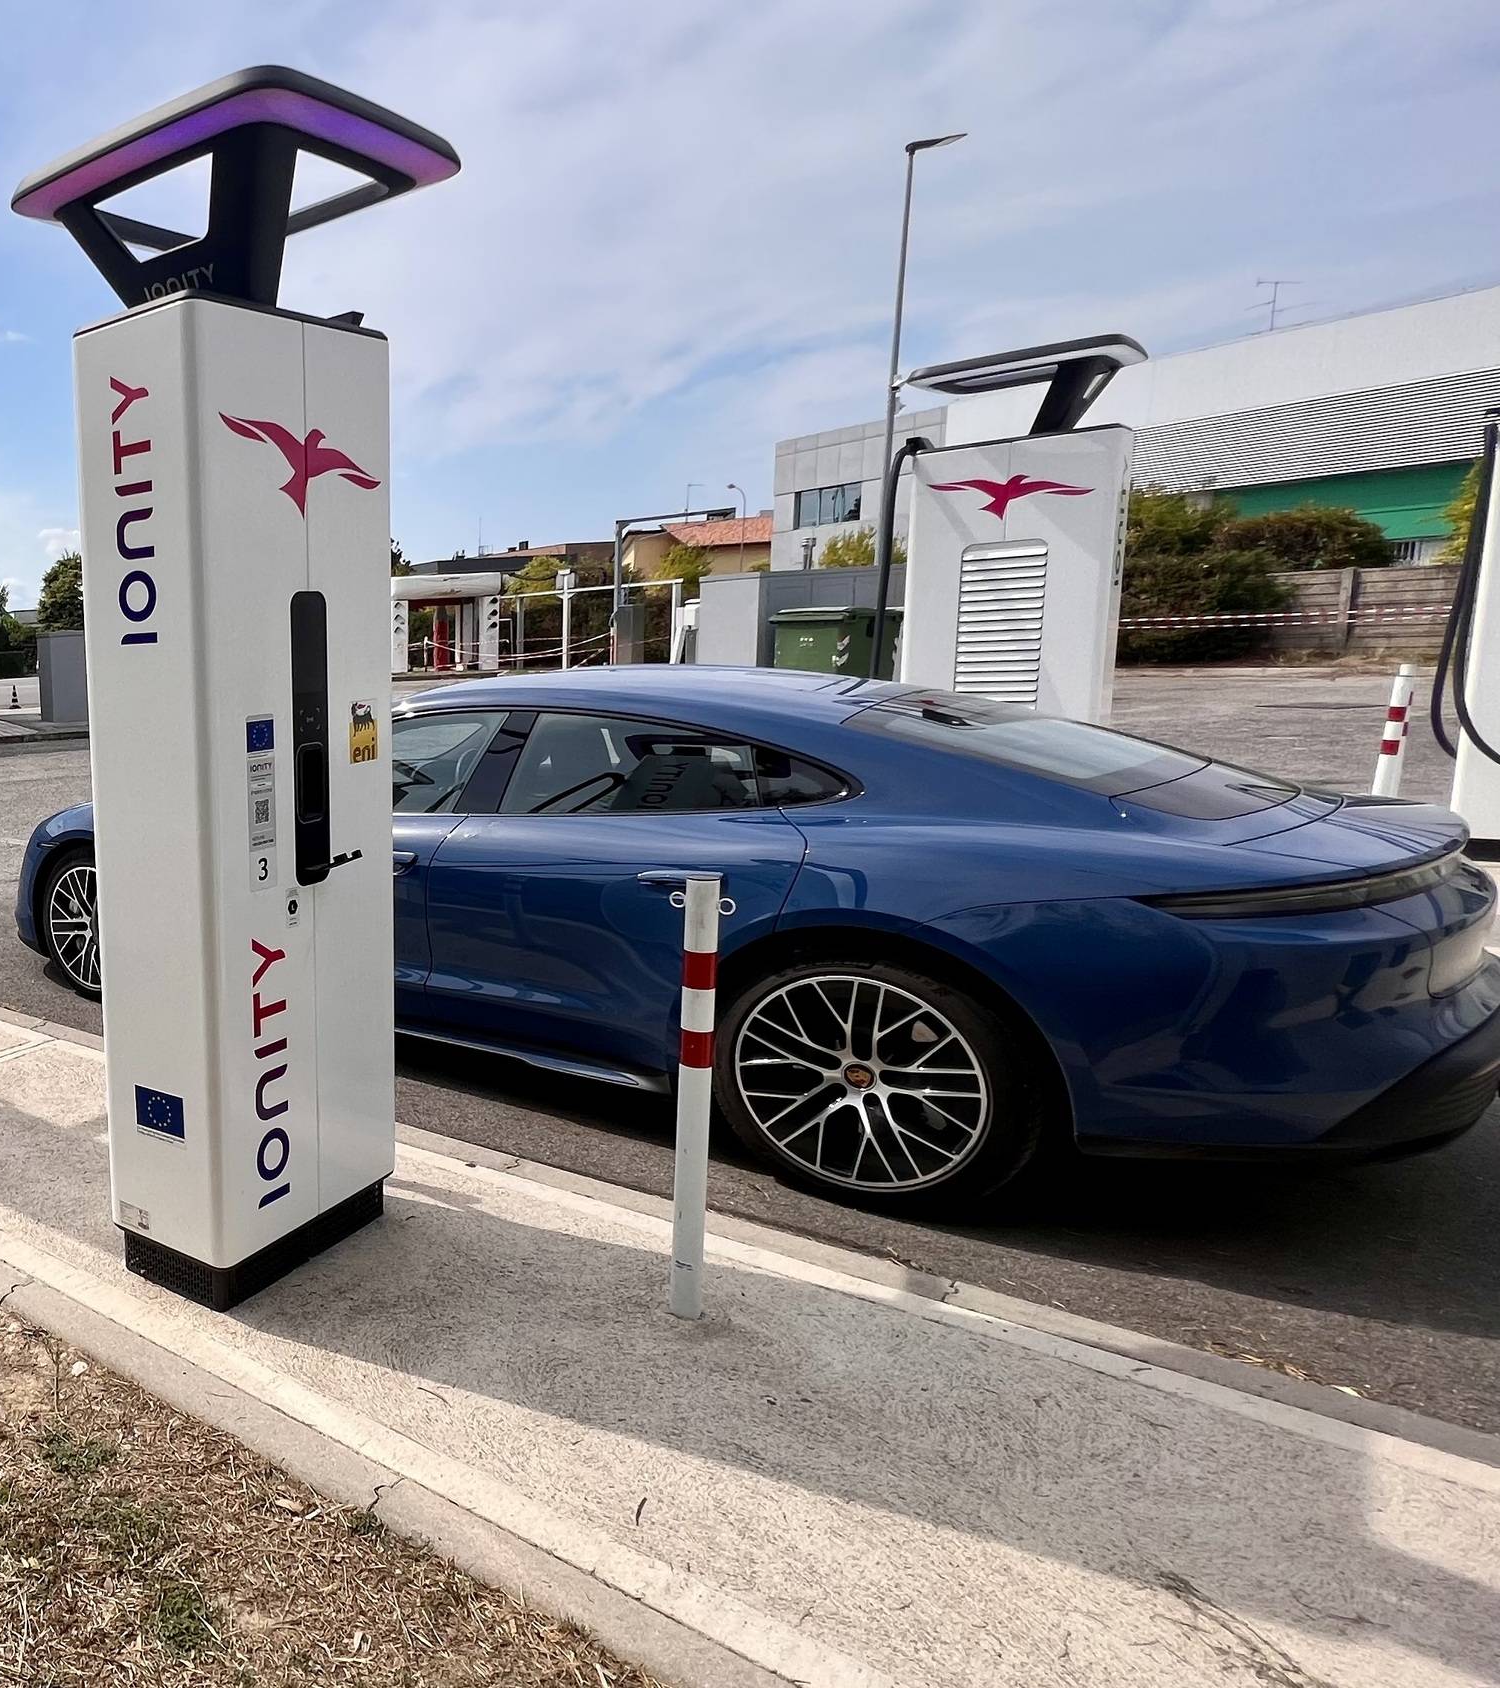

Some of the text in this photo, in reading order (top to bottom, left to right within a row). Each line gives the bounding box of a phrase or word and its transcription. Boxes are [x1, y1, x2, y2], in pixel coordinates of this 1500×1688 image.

[143, 263, 214, 301] IONITY
[109, 374, 157, 646] IONITY
[352, 736, 377, 763] eni
[258, 857, 269, 881] 3
[251, 937, 291, 1210] IONITY
